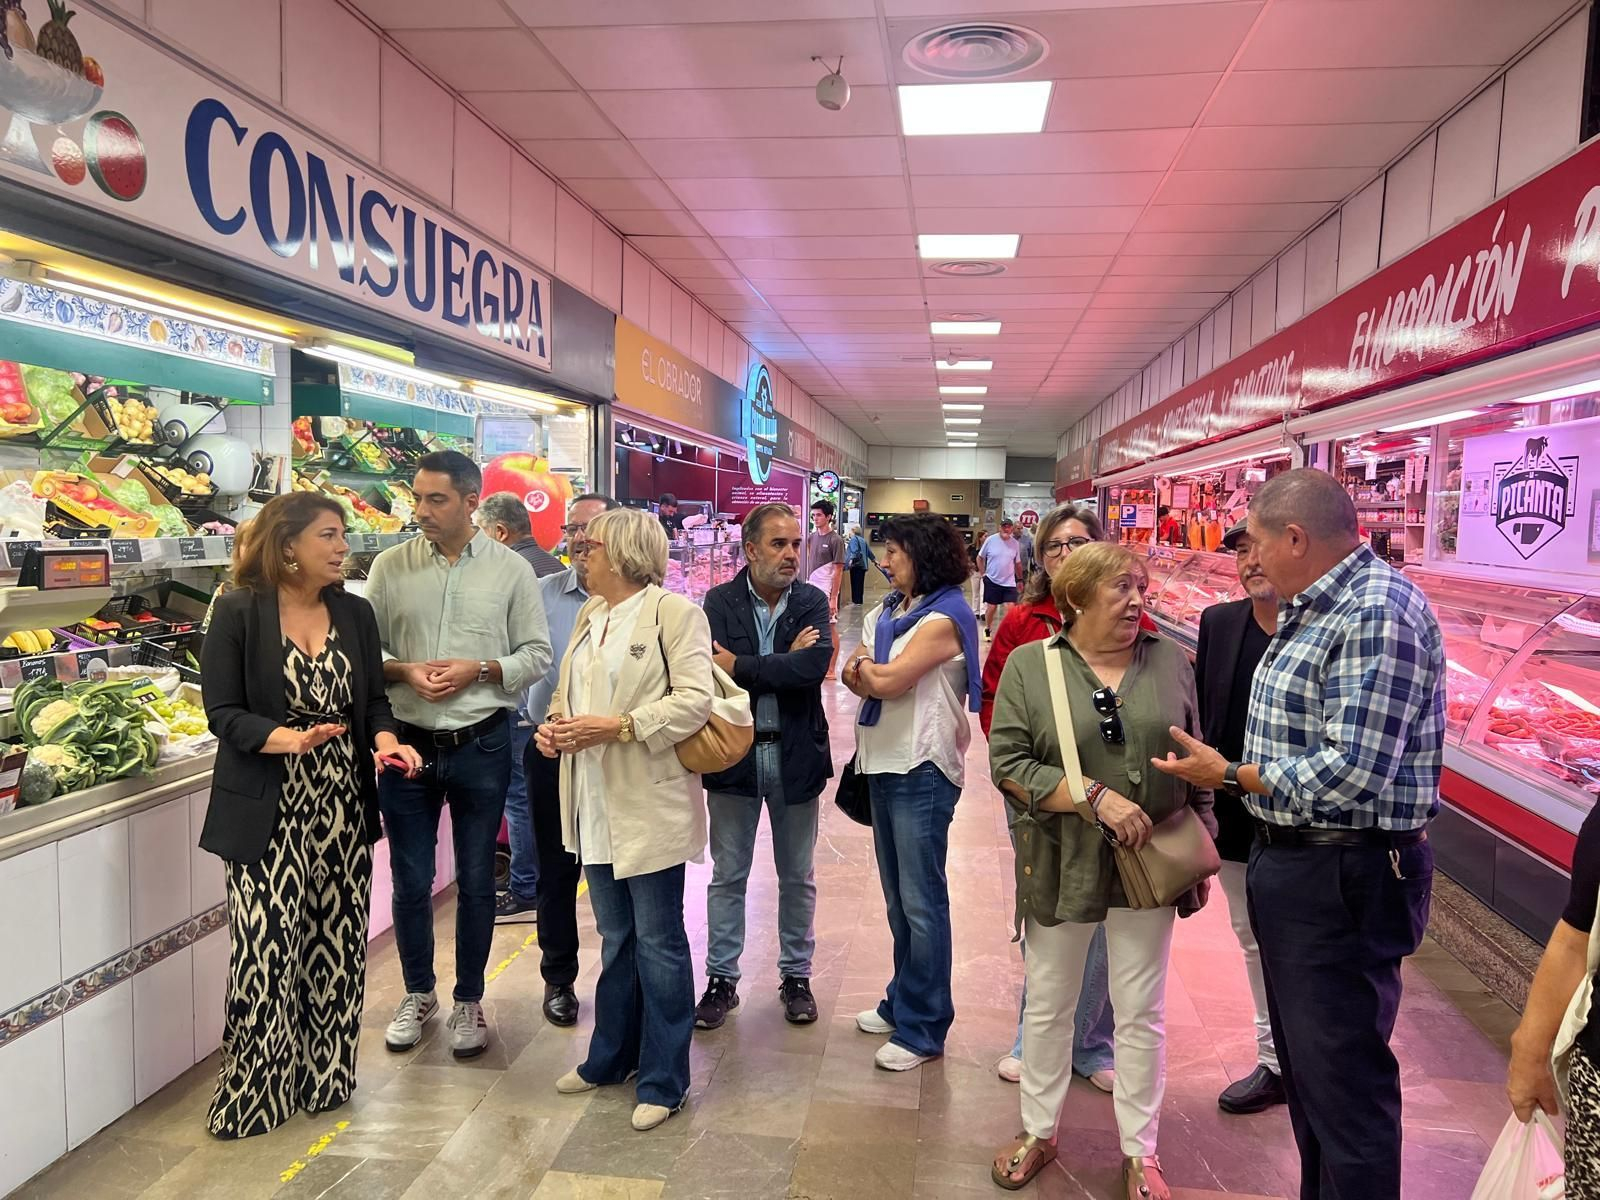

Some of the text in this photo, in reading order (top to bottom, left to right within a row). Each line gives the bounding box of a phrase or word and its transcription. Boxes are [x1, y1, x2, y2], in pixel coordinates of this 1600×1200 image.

[185, 98, 546, 358] CONSUEGRA
[1350, 209, 1532, 372] ELABORACIÓN
[641, 347, 702, 406] EL OBRADOR
[1122, 506, 1135, 519] P
[1500, 479, 1564, 524] PICANTA
